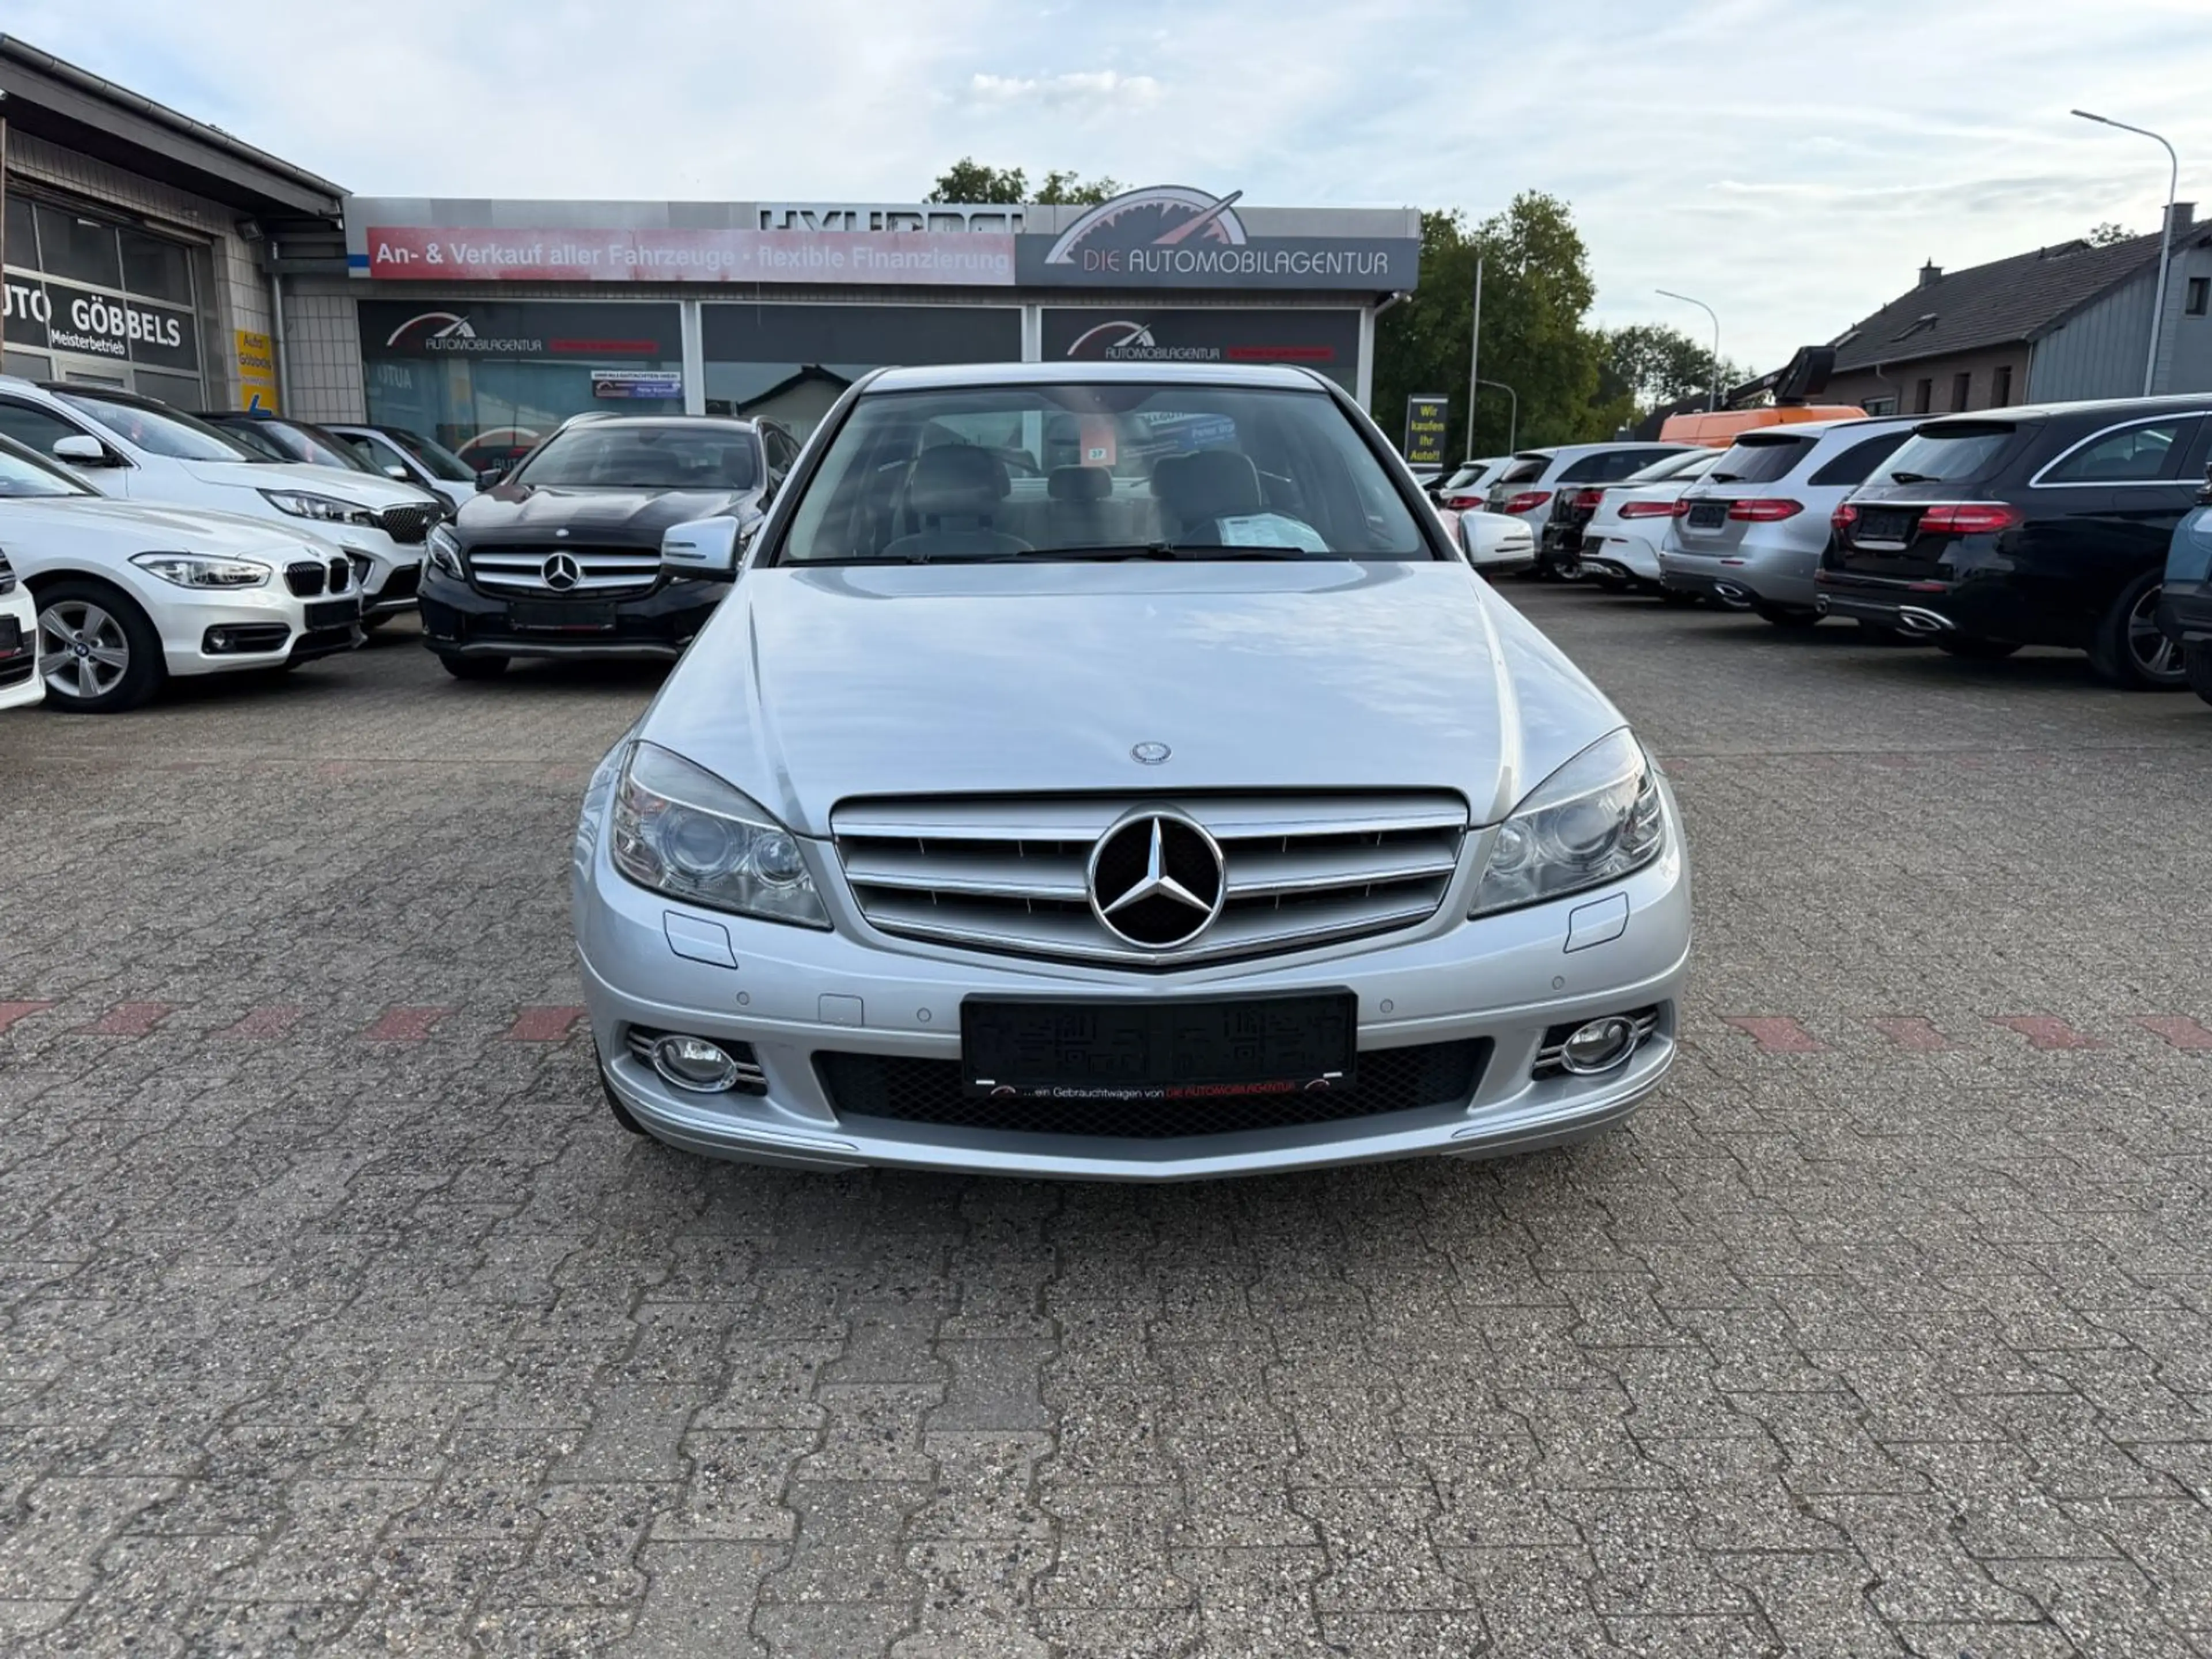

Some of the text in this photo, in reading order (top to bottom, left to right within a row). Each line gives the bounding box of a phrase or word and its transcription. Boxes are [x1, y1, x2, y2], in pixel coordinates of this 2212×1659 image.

[376, 243, 419, 264] An-
[426, 243, 443, 264] &
[449, 243, 543, 265] Verkauf
[550, 244, 601, 266] aller
[608, 244, 736, 271] Fahrzeuge
[757, 245, 845, 267] flexible
[853, 247, 1009, 275] Finanzierung
[1083, 249, 1389, 274] DIE AUTOMOBILAGENTUR
[71, 294, 181, 347] GÖBBELS
[51, 328, 126, 355] Meisterbetrieb
[425, 338, 541, 351] AUTOMOBILAGENTUR
[1105, 347, 1220, 360] AUTOMOBILAGENTUR
[1420, 405, 1438, 417] Wir
[1411, 420, 1445, 432] kaufen
[1419, 433, 1434, 446] Ihr
[1053, 1086, 1142, 1101] Gebrauchtwagen
[1144, 1088, 1165, 1099] von
